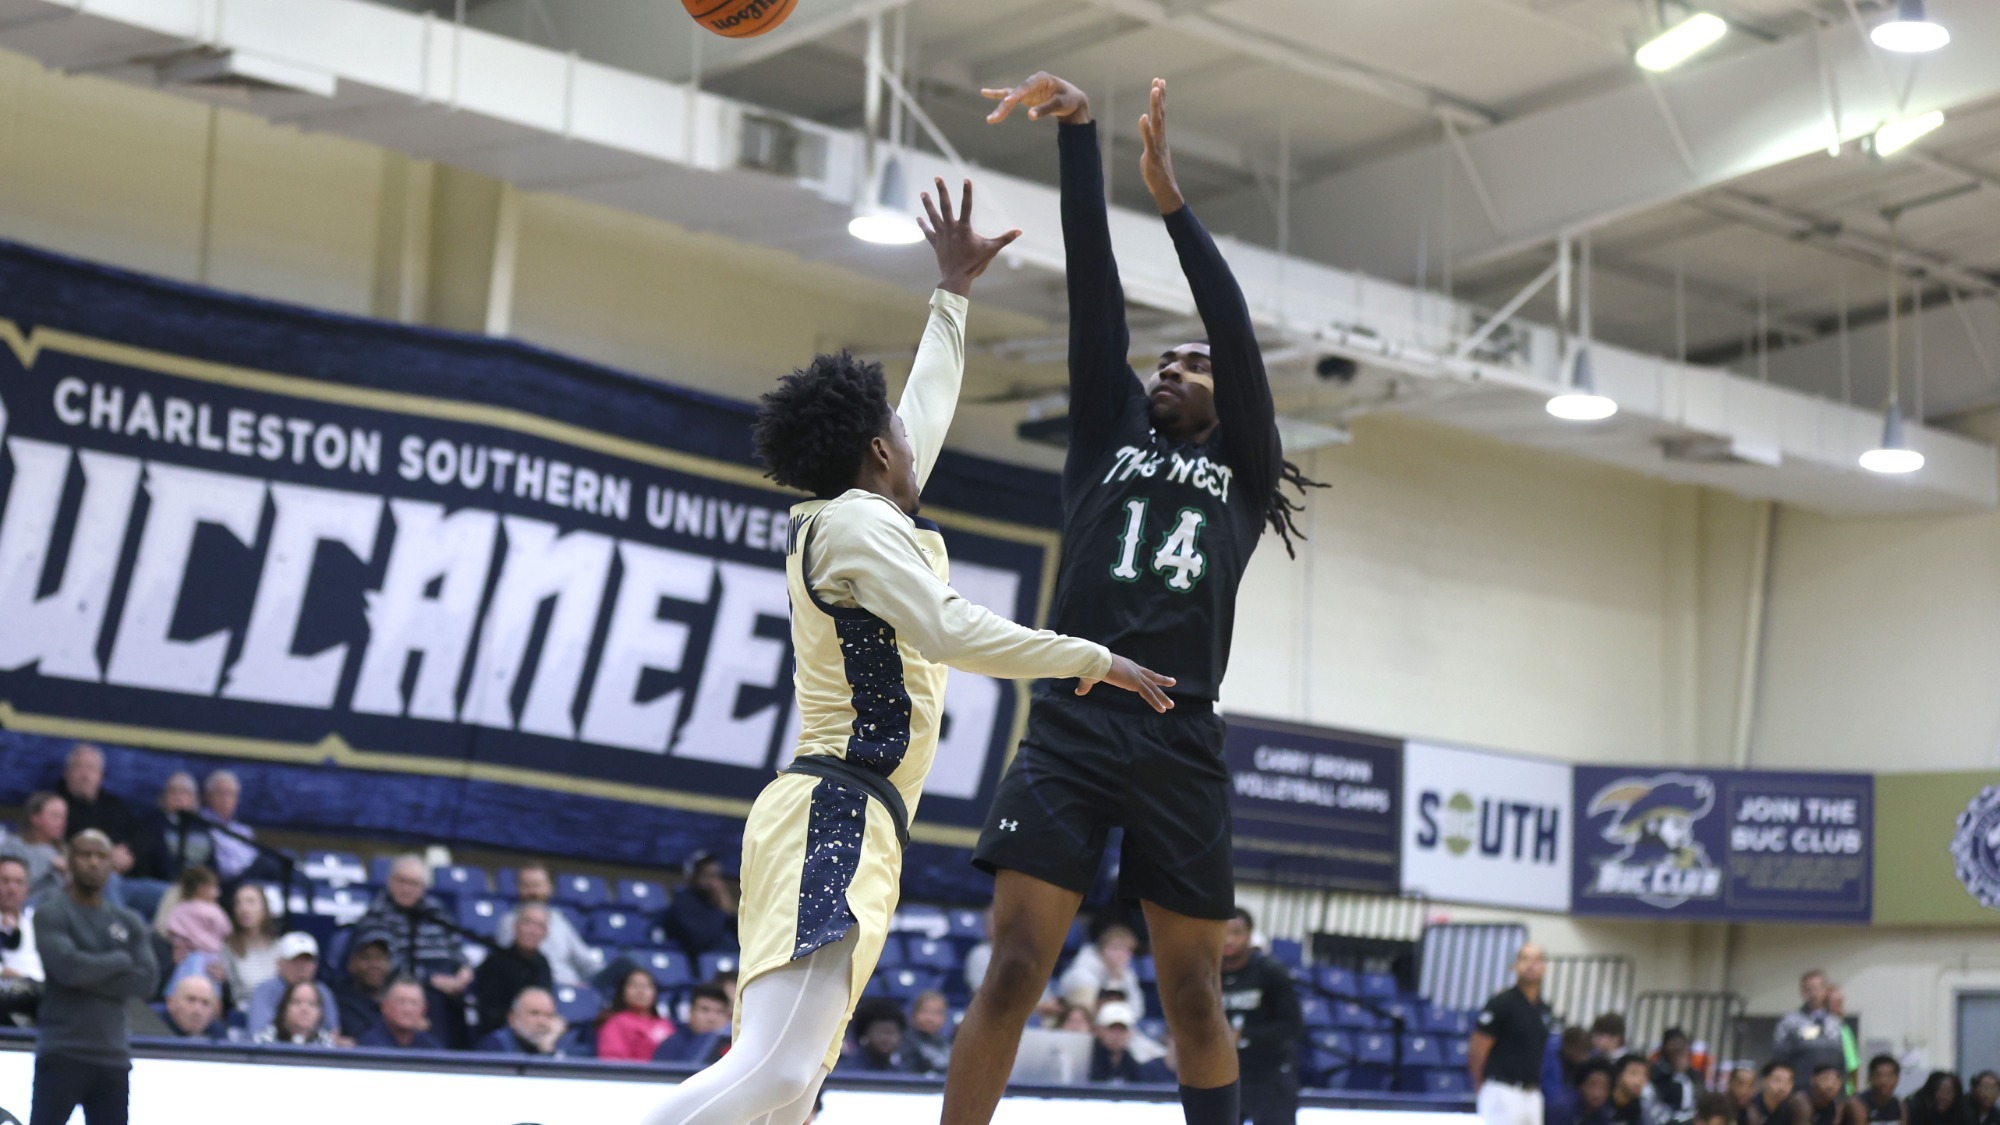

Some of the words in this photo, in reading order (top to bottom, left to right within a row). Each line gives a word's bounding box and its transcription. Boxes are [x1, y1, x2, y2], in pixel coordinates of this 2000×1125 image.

[53, 376, 382, 475] CHARLESTON
[398, 435, 632, 521] SOUTHERN
[645, 485, 789, 553] UNIVER
[1110, 497, 1206, 593] 14
[1731, 824, 1788, 853] BUC
[1791, 826, 1862, 855] CLUB
[1736, 795, 1801, 823] JOIN
[1804, 798, 1858, 825] THE
